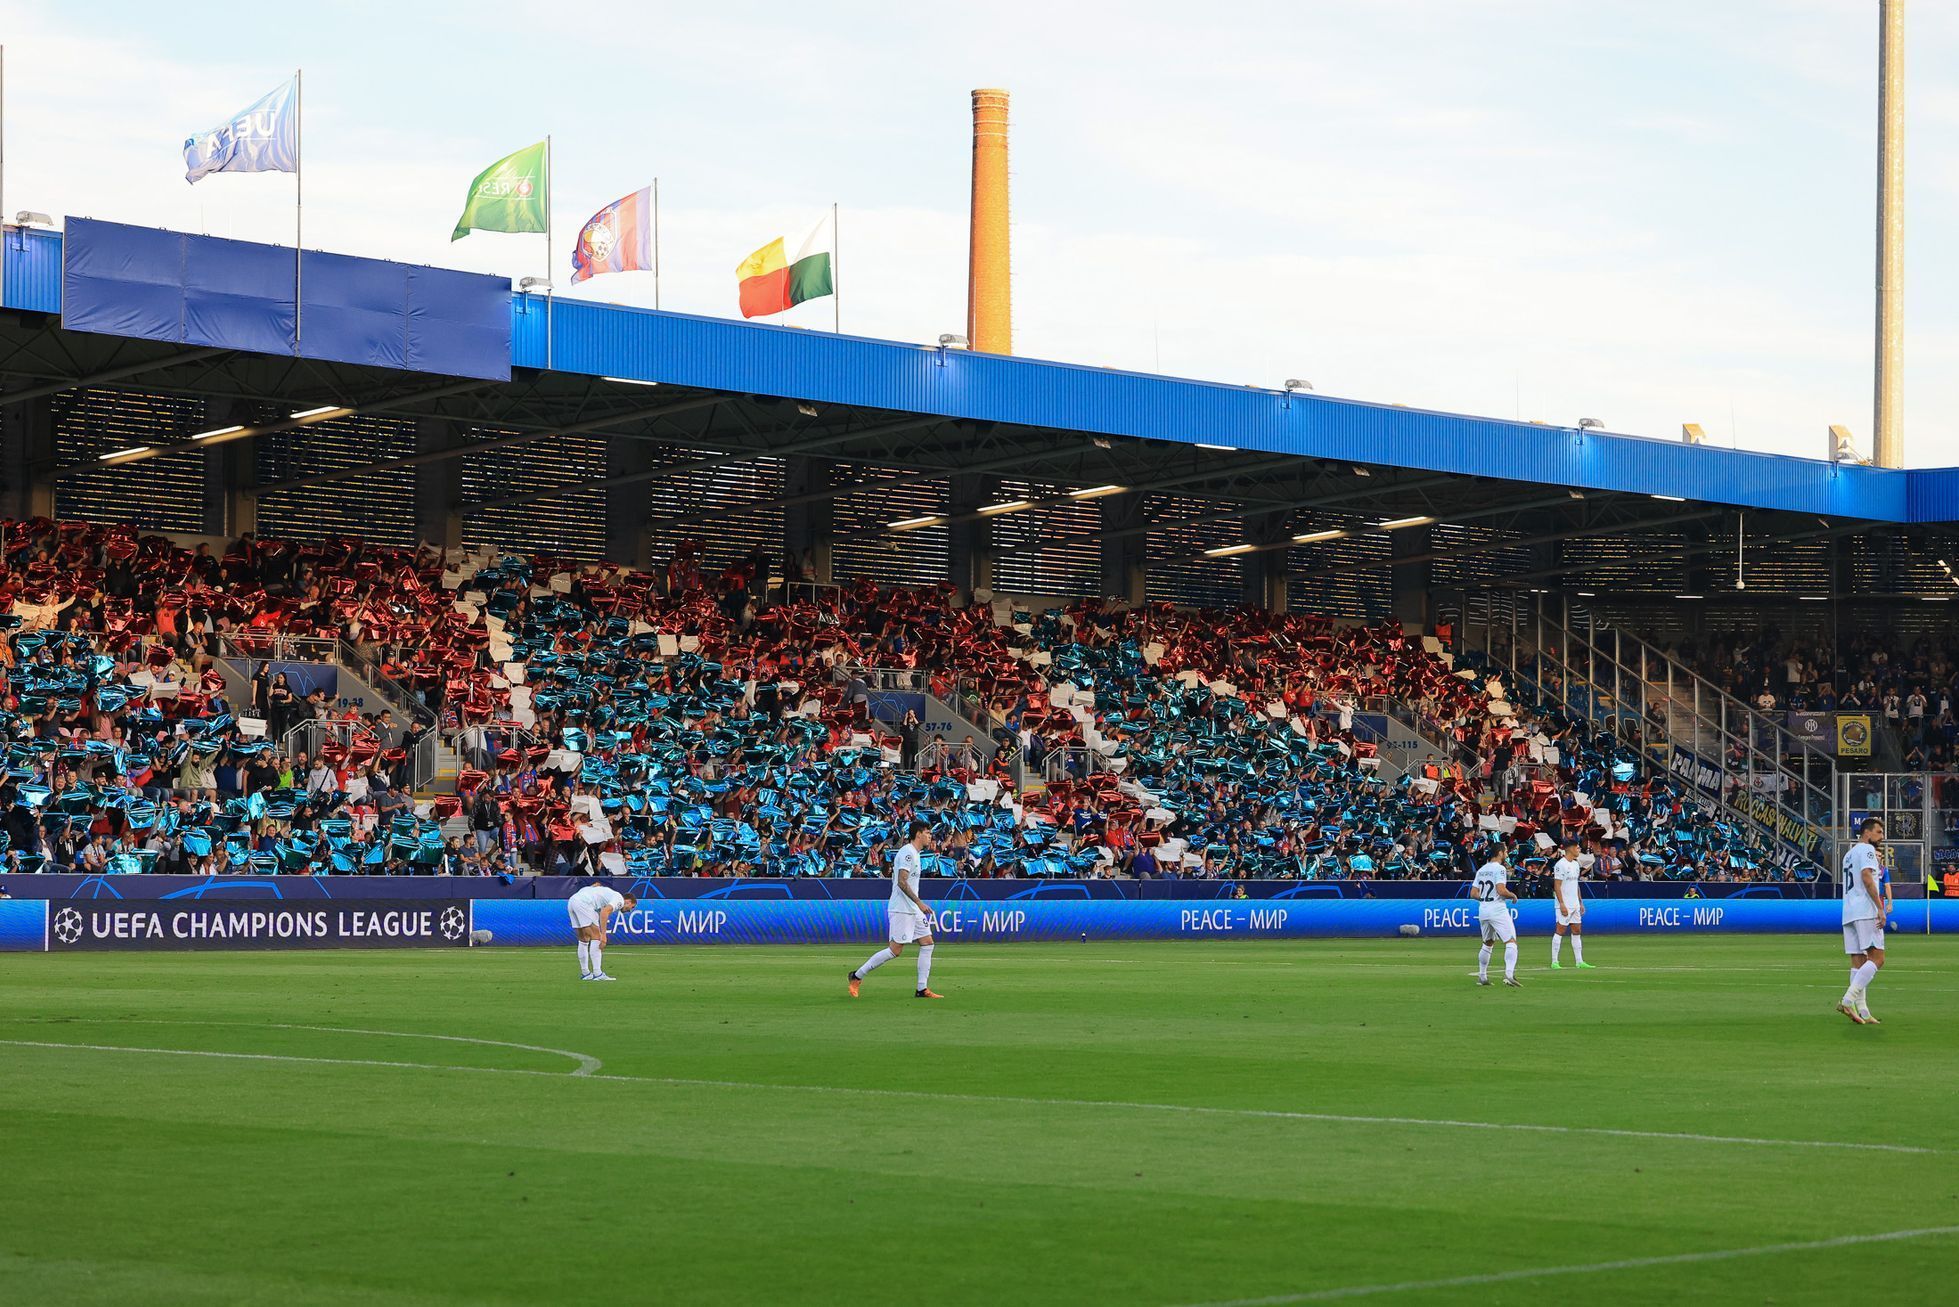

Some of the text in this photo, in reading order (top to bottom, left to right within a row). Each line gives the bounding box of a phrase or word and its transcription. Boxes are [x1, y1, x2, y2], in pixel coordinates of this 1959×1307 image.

[925, 722, 953, 732] 57-76
[1478, 880, 1495, 902] 22
[92, 911, 433, 938] UEFA CHAMPIONS LEAGUE
[677, 910, 727, 934] МИР
[928, 910, 963, 933] ACE
[982, 910, 1026, 932] МИР
[1181, 909, 1233, 930] PEACE
[1249, 909, 1288, 929] МИР
[1424, 908, 1470, 928] PEACE
[1639, 907, 1680, 926] PEACE
[1693, 907, 1724, 926] МИР
